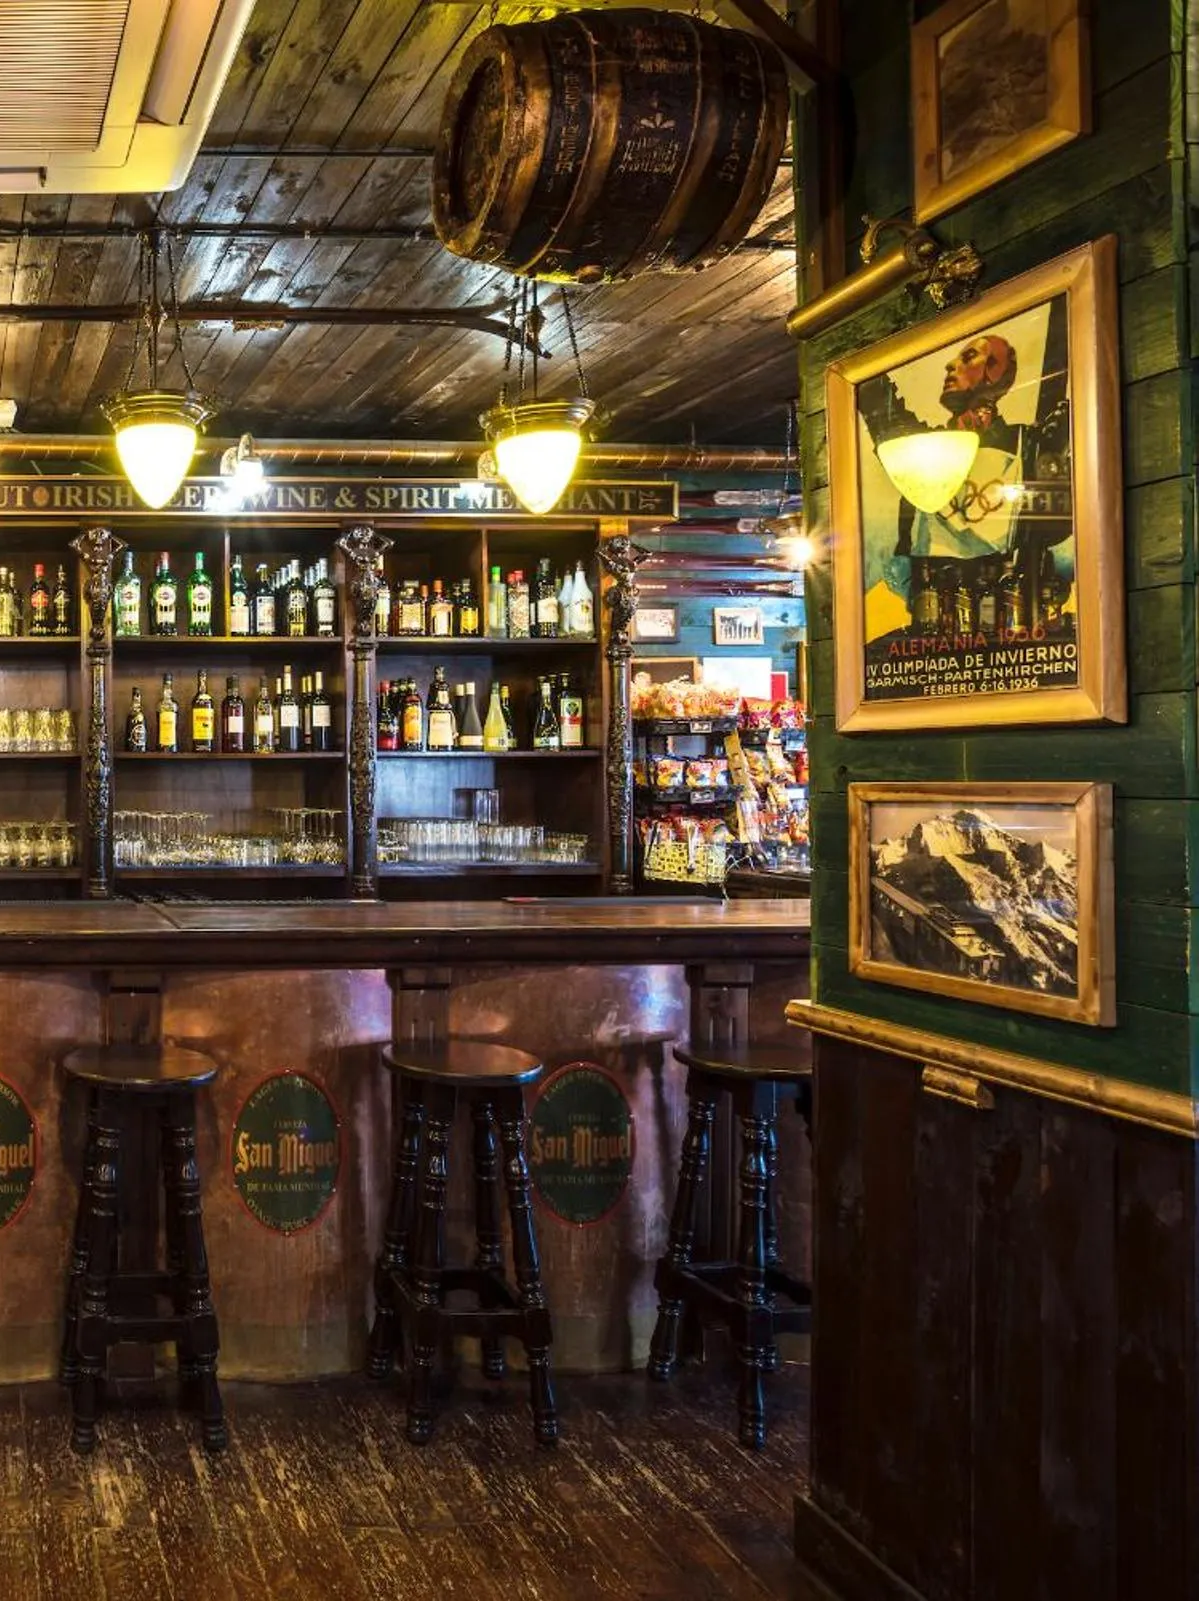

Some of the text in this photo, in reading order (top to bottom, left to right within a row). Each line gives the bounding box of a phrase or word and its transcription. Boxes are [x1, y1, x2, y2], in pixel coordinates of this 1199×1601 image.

[53, 485, 133, 508] IRISH
[247, 486, 327, 509] WINE
[334, 486, 357, 509] &
[365, 486, 458, 510] SPIRIT
[887, 631, 988, 658] ALEMANIA
[866, 665, 879, 678] IV
[964, 653, 984, 669] DE
[990, 643, 1077, 666] INVIERNO
[867, 660, 1077, 689] GARMISCH-PARTENKIRCHEN
[923, 682, 976, 696] FEBRERO
[234, 1131, 273, 1174] San
[531, 1123, 632, 1168] San Miguel
